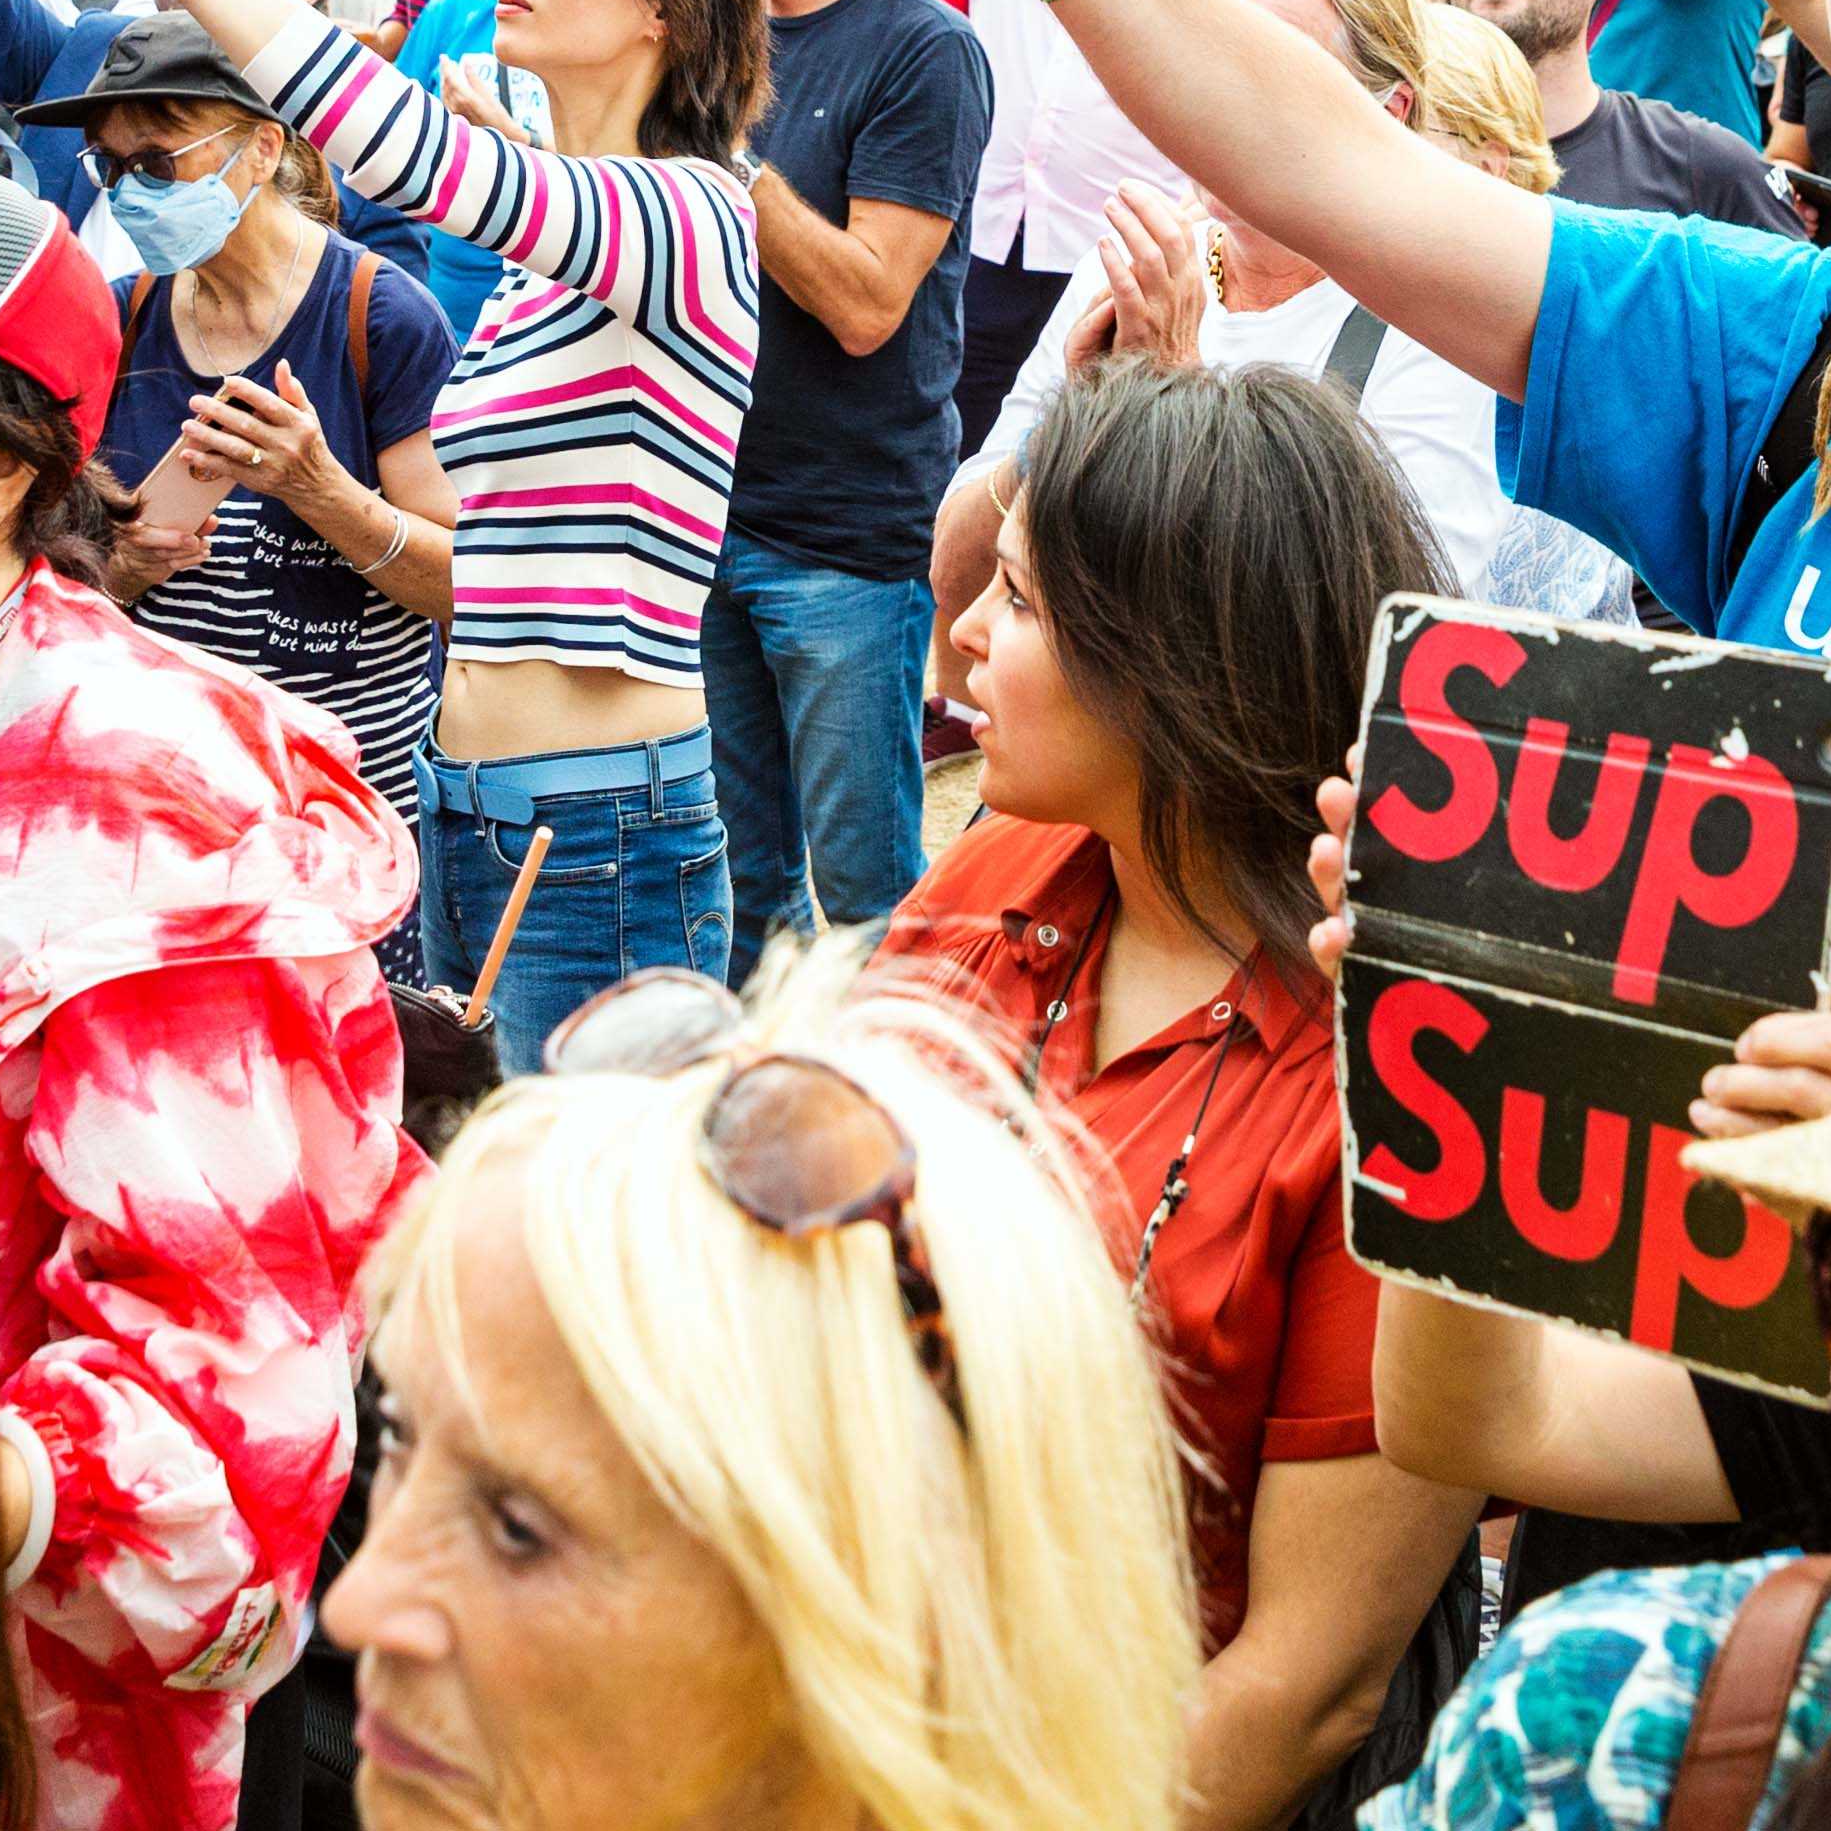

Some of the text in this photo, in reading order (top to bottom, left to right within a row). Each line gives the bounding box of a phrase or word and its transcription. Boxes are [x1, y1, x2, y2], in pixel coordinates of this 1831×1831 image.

[269, 630, 299, 652] but
[304, 638, 339, 653] nine
[304, 620, 358, 635] waste
[1366, 622, 1799, 1006] Sup
[1362, 981, 1792, 1352] Sup
